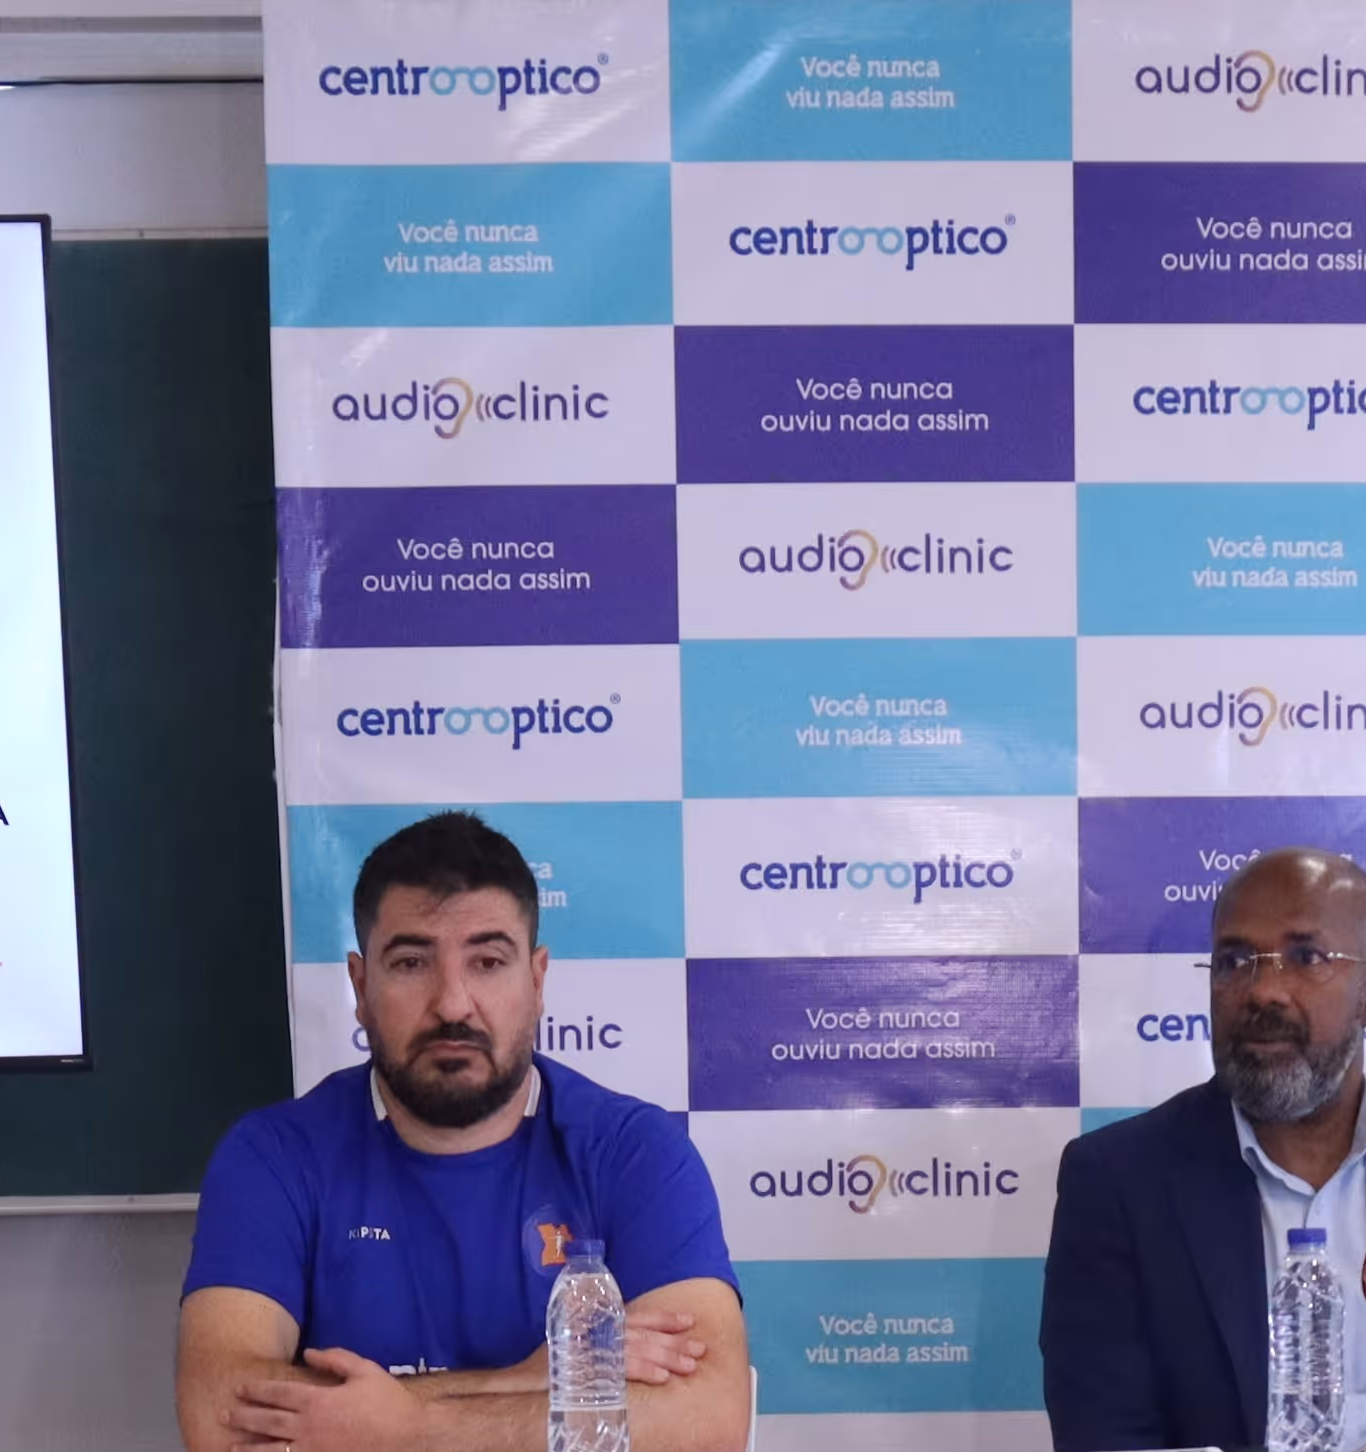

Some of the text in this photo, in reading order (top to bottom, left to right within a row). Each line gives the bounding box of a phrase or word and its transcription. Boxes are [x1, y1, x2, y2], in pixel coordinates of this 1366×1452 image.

[800, 54, 941, 78] Você nunca
[785, 85, 955, 109] viu nada assim
[397, 218, 538, 244] Você nunca
[1196, 216, 1352, 240] Você nunca
[383, 250, 554, 273] viu nada assim
[1161, 248, 1231, 271] ouviu
[1239, 248, 1309, 271] nada
[796, 377, 953, 401] Você nunca
[760, 408, 989, 433] ouviu nada assim
[396, 537, 554, 560] Você nunca
[1206, 534, 1344, 558] Você nunca
[362, 567, 591, 594] ouviu nada assim
[1191, 565, 1358, 588] viu nada assim
[808, 693, 948, 717] Você nunca
[795, 724, 962, 746] viu nada assim
[1164, 880, 1223, 902] ouvi
[805, 1006, 960, 1030] Você nunca
[771, 1035, 995, 1061] ouviu nada assim
[819, 1311, 954, 1335] Você nunca
[805, 1341, 968, 1363] viu nada assim
